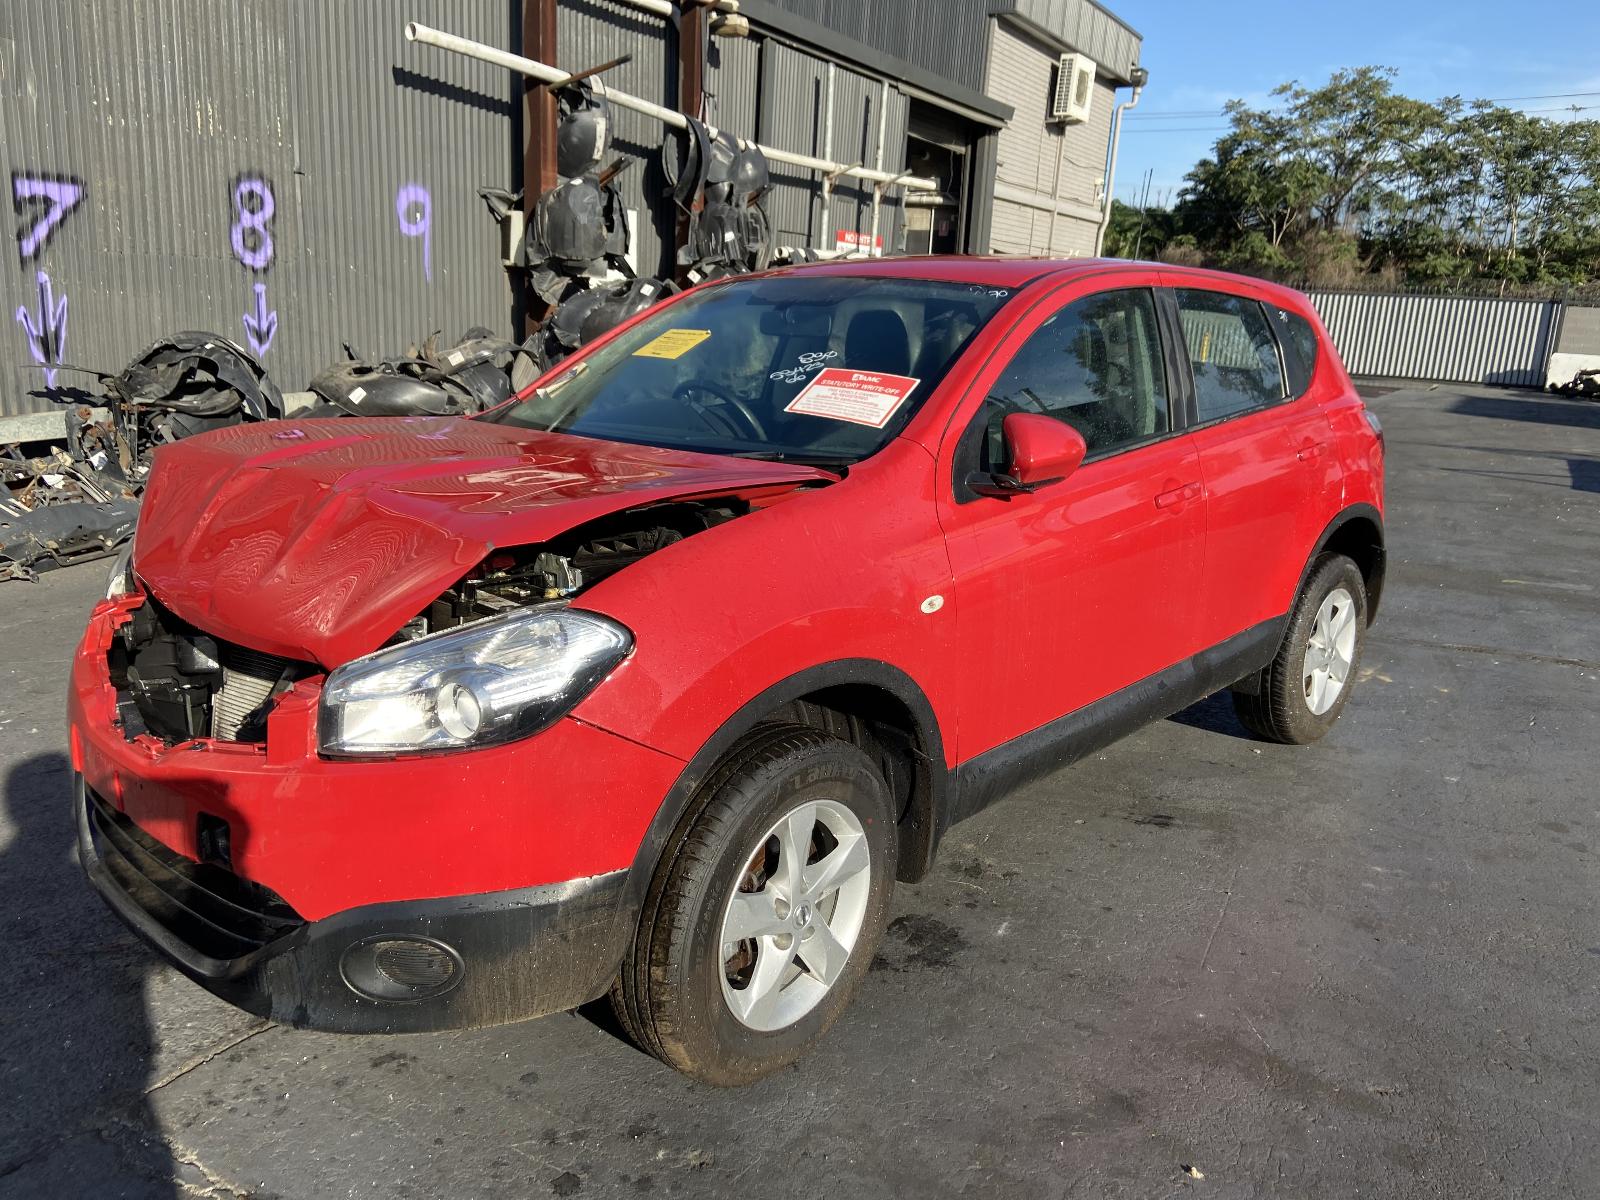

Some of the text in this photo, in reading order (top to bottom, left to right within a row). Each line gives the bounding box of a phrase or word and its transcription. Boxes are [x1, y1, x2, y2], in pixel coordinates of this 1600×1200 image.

[12, 171, 88, 271] 7
[229, 172, 277, 273] 8
[397, 182, 432, 282] 9
[821, 379, 861, 388] STATUTORY
[861, 384, 901, 394] WRITE-OFF
